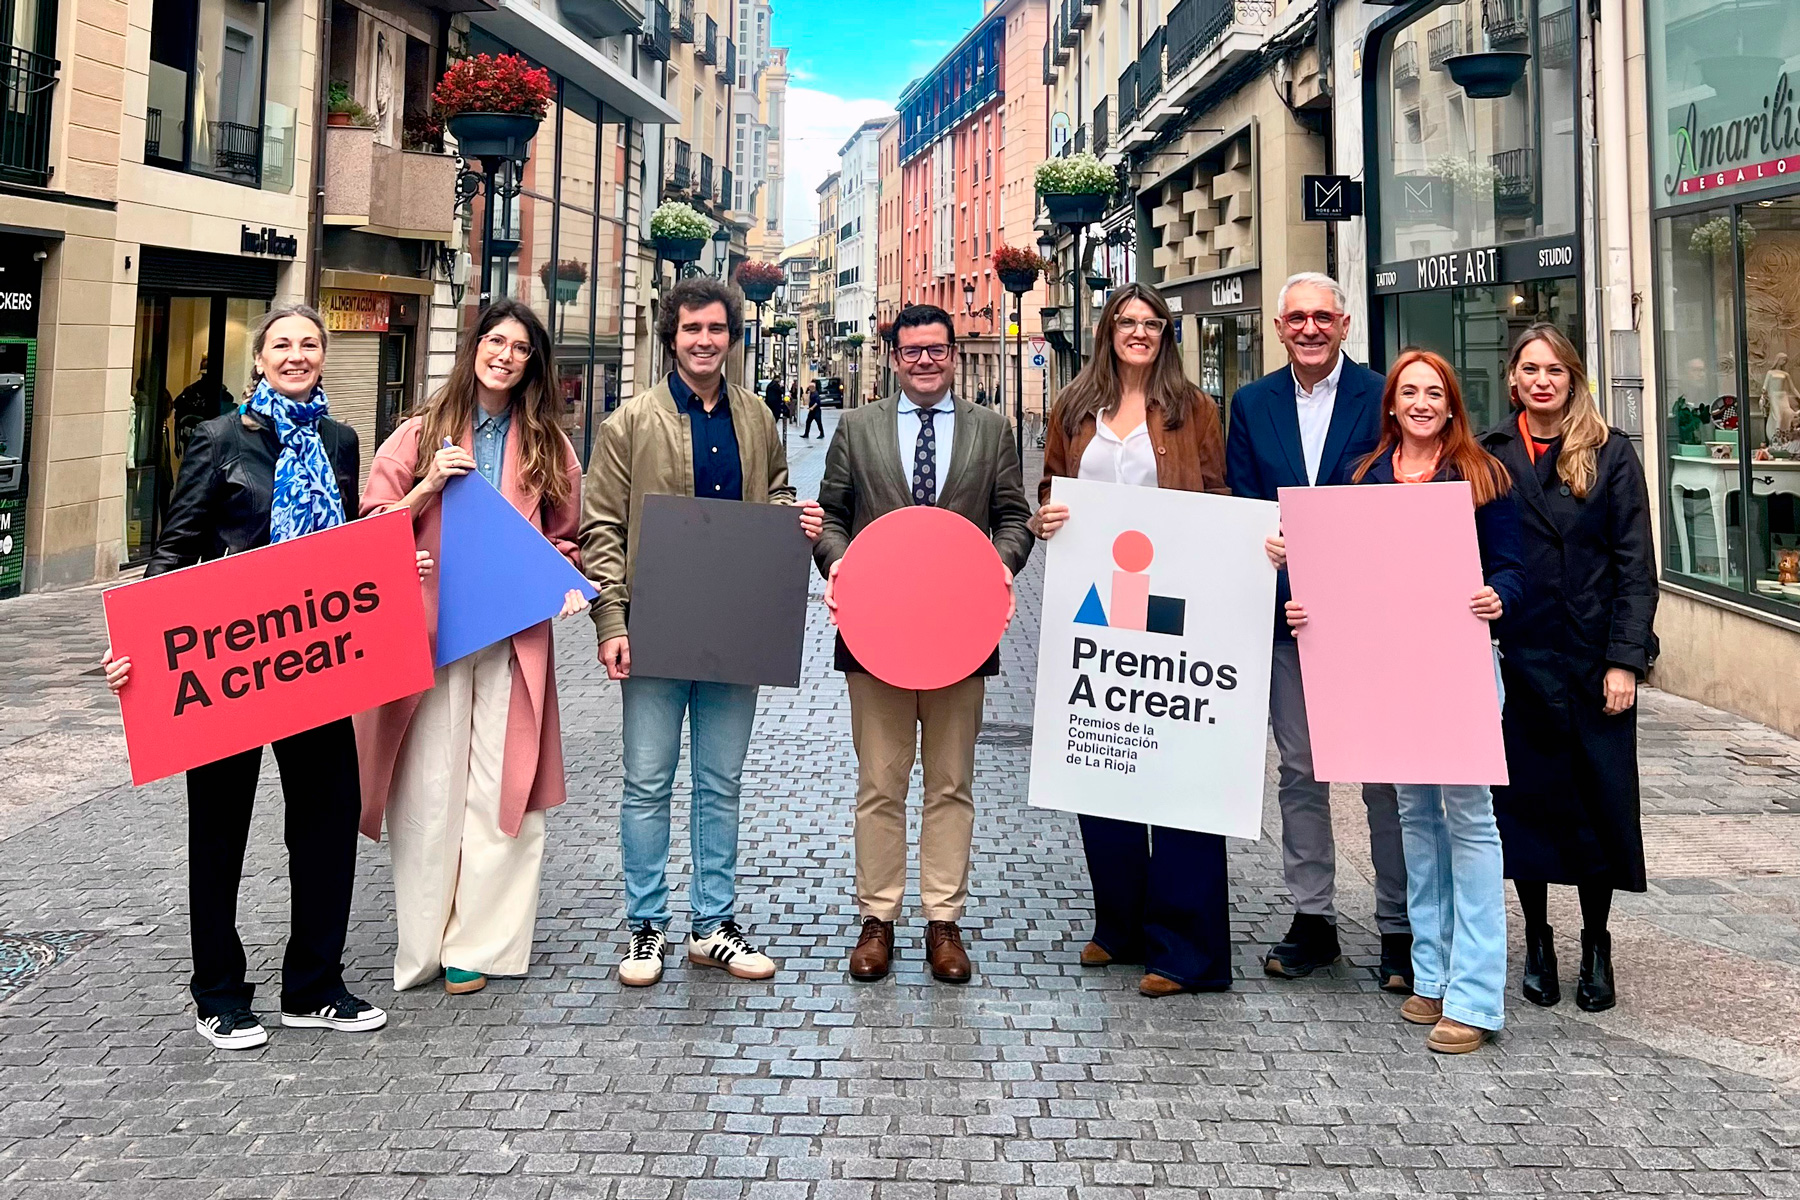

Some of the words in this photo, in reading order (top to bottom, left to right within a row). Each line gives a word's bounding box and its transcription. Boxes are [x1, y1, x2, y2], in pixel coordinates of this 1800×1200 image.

[1376, 271, 1397, 287] TATTOO
[1417, 254, 1459, 288] MORE
[1465, 249, 1496, 284] ART
[1538, 246, 1572, 267] STUDIO
[164, 582, 380, 671] Premios
[173, 670, 213, 717] A
[221, 631, 364, 699] crear.
[1072, 636, 1238, 690] Premios
[1068, 674, 1097, 708] A
[1105, 686, 1216, 724] crear.
[1068, 727, 1158, 750] Comunicación
[1069, 713, 1121, 731] Premios
[1124, 722, 1140, 733] de
[1143, 724, 1154, 736] la
[1066, 753, 1082, 765] de
[1085, 755, 1100, 767] La
[1104, 758, 1136, 775] Rioja
[1067, 740, 1138, 760] Publicitaria
